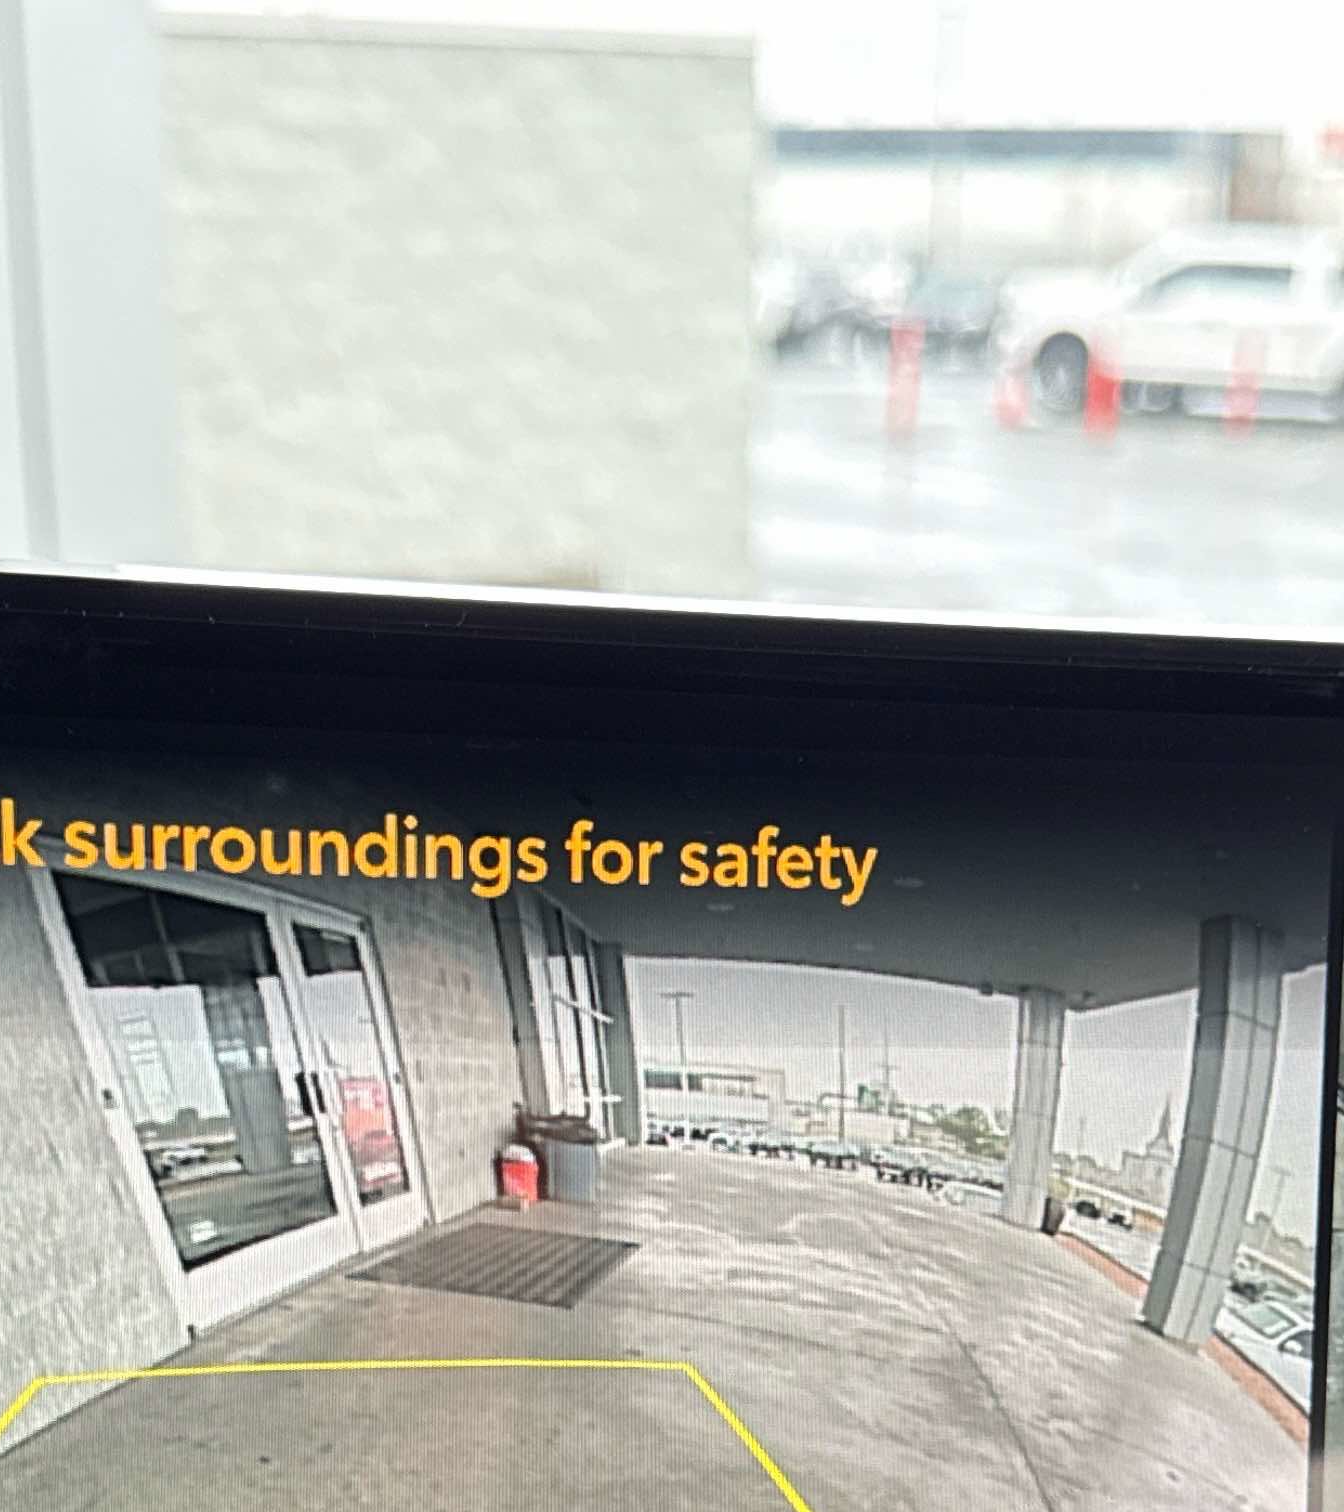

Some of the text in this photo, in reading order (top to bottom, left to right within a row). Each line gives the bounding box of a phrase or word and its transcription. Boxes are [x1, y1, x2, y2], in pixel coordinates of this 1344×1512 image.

[63, 814, 549, 899] surroundings
[563, 820, 663, 886] for
[679, 825, 879, 905] safety
